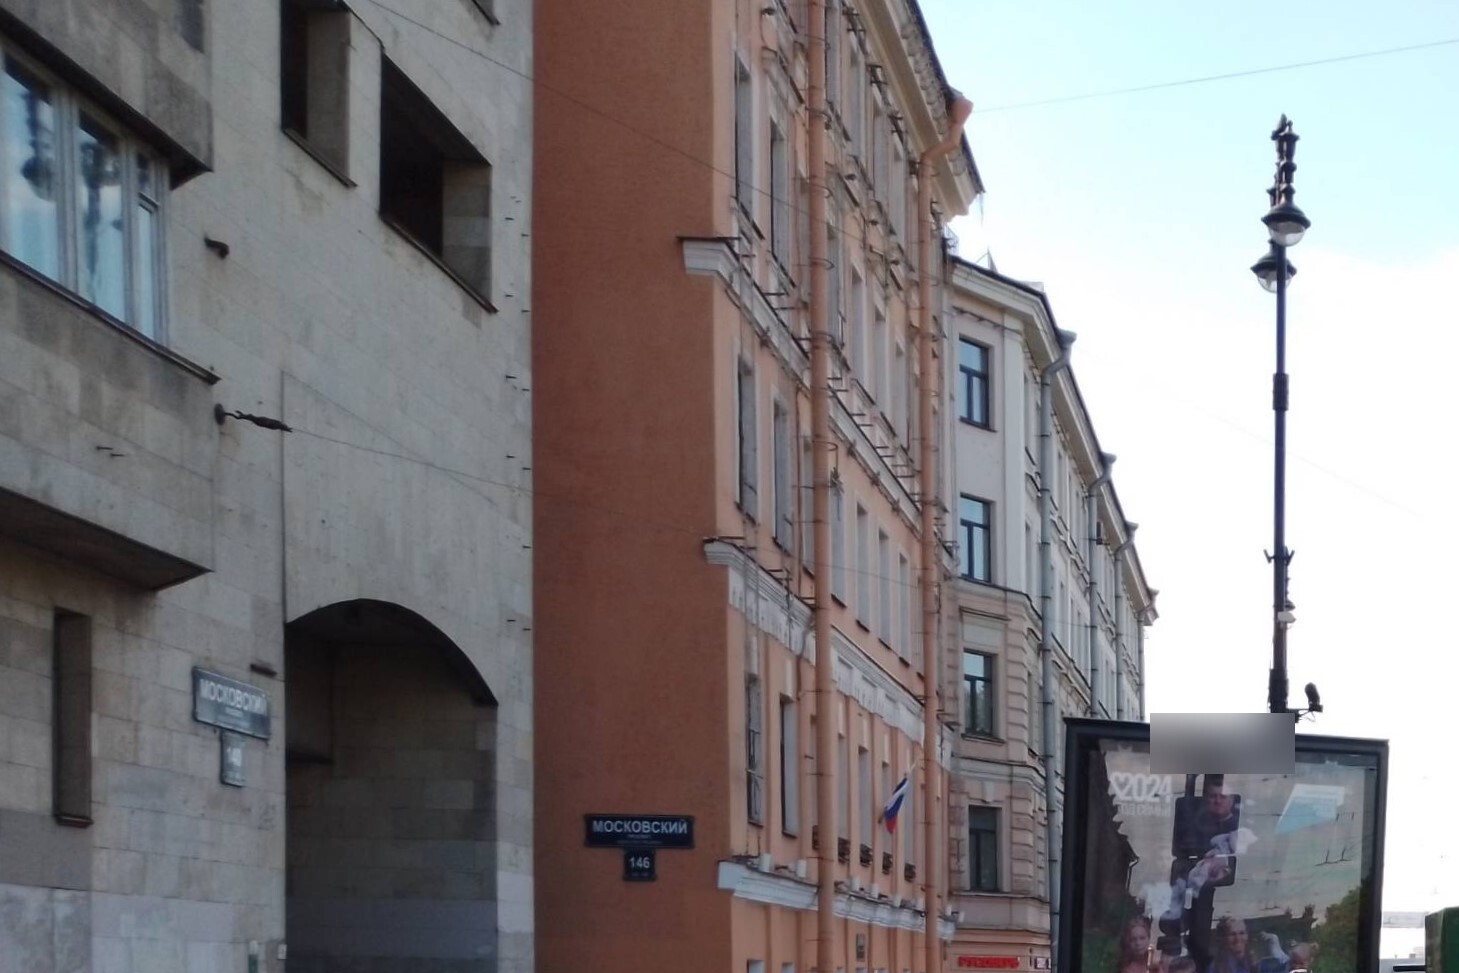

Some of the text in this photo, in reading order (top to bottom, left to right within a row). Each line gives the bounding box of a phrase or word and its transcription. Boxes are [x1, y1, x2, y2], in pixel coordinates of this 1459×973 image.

[1120, 773, 1172, 803] 2024
[592, 819, 688, 834] МОСКОВСКИЙ
[629, 857, 650, 869] 146
